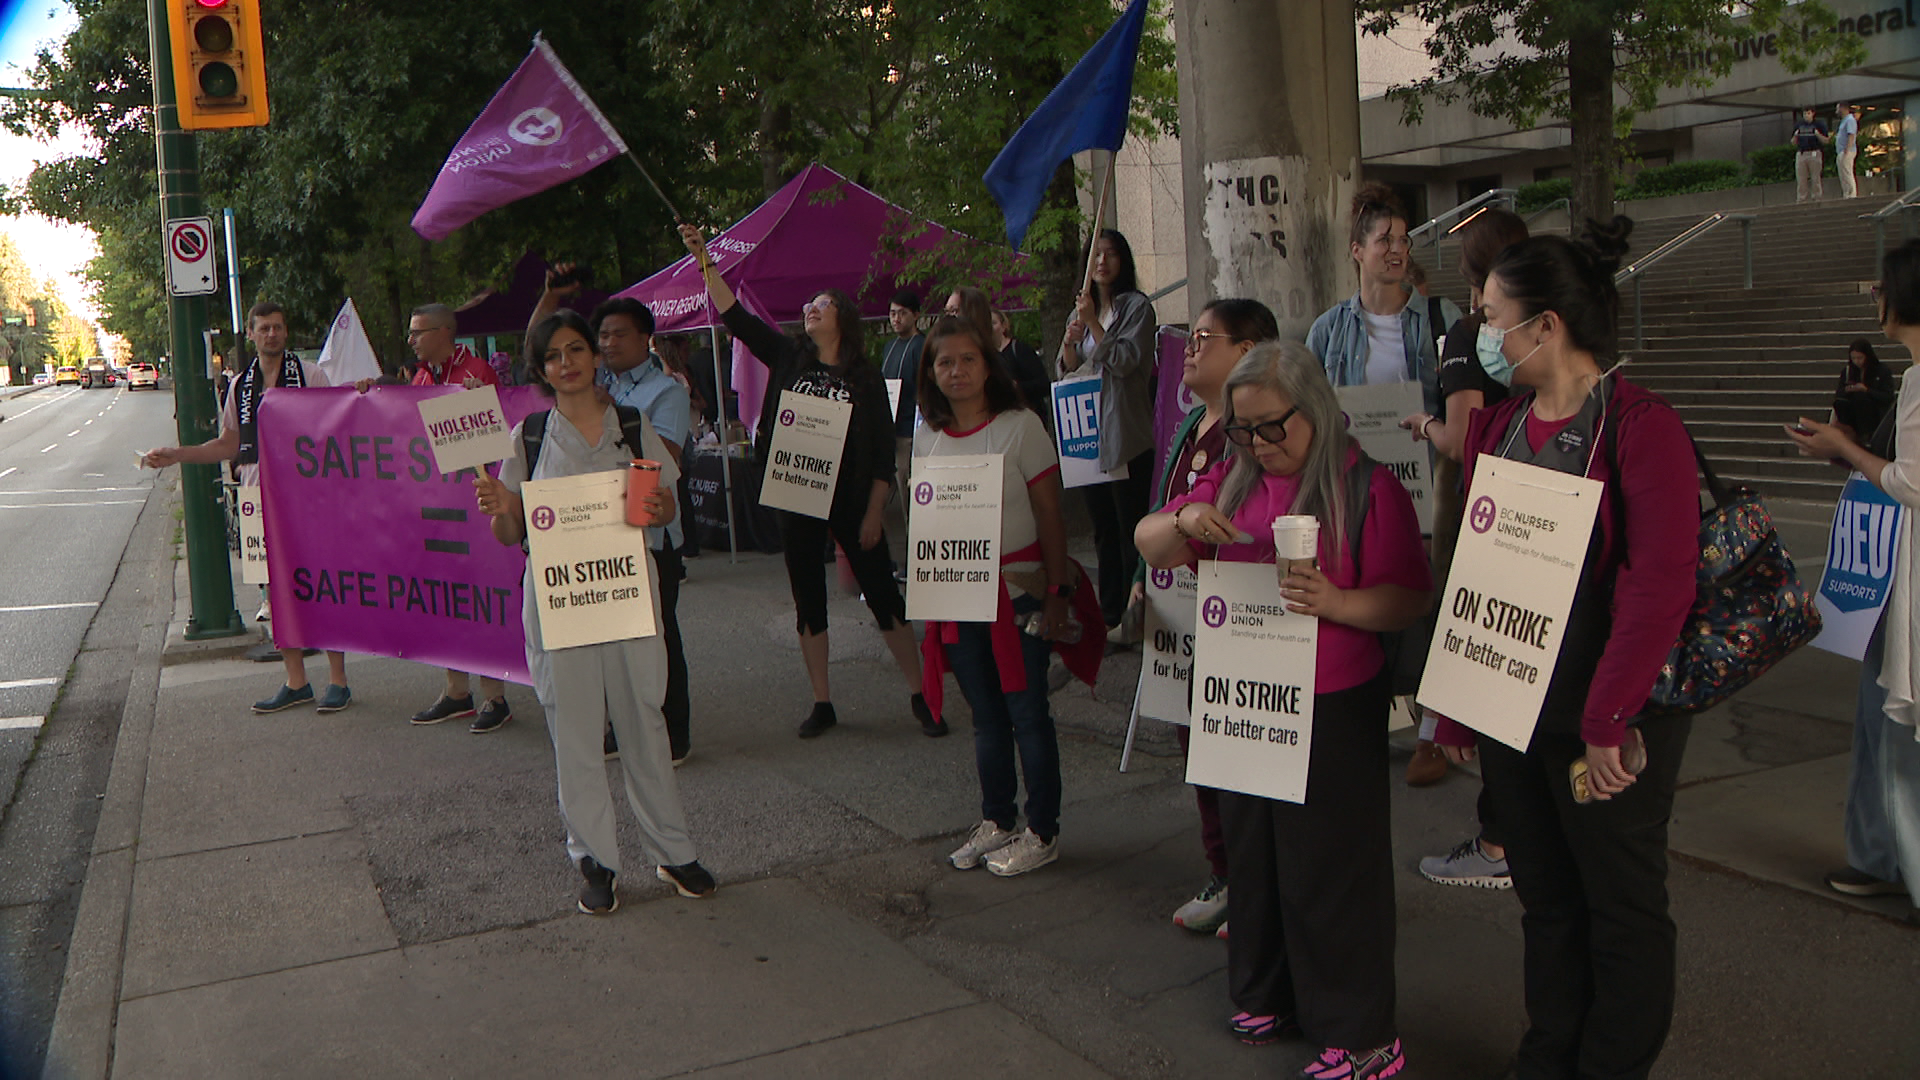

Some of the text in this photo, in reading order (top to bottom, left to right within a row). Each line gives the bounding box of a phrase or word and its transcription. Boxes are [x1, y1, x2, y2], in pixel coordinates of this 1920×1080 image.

[295, 435, 397, 481] SAFE
[1068, 441, 1099, 452] SUPPO
[775, 450, 832, 476] ON STRIKE
[772, 469, 828, 491] for better care
[936, 493, 961, 501] UNION
[247, 536, 259, 548] ON
[1497, 521, 1531, 540] UNION
[1831, 499, 1897, 579] HEU
[917, 540, 991, 560] ON STRIKE
[1494, 538, 1520, 554] Standing
[1540, 552, 1561, 566] health
[544, 555, 637, 588] ON STRIKE
[916, 566, 989, 582] for better care
[293, 567, 511, 627] SAFE PATIENT
[548, 586, 639, 610] for better care
[1828, 580, 1877, 600] SUPPORTS
[1231, 616, 1263, 627] UNION
[1245, 604, 1285, 617] NURSES
[1453, 587, 1552, 650] ON STRIKE
[1154, 629, 1177, 654] ON
[1231, 629, 1311, 644] Standing up for health care
[1443, 628, 1538, 684] for better care
[1153, 660, 1171, 678] for
[1204, 676, 1301, 715] ON STRIKE
[1203, 713, 1298, 746] for better care
